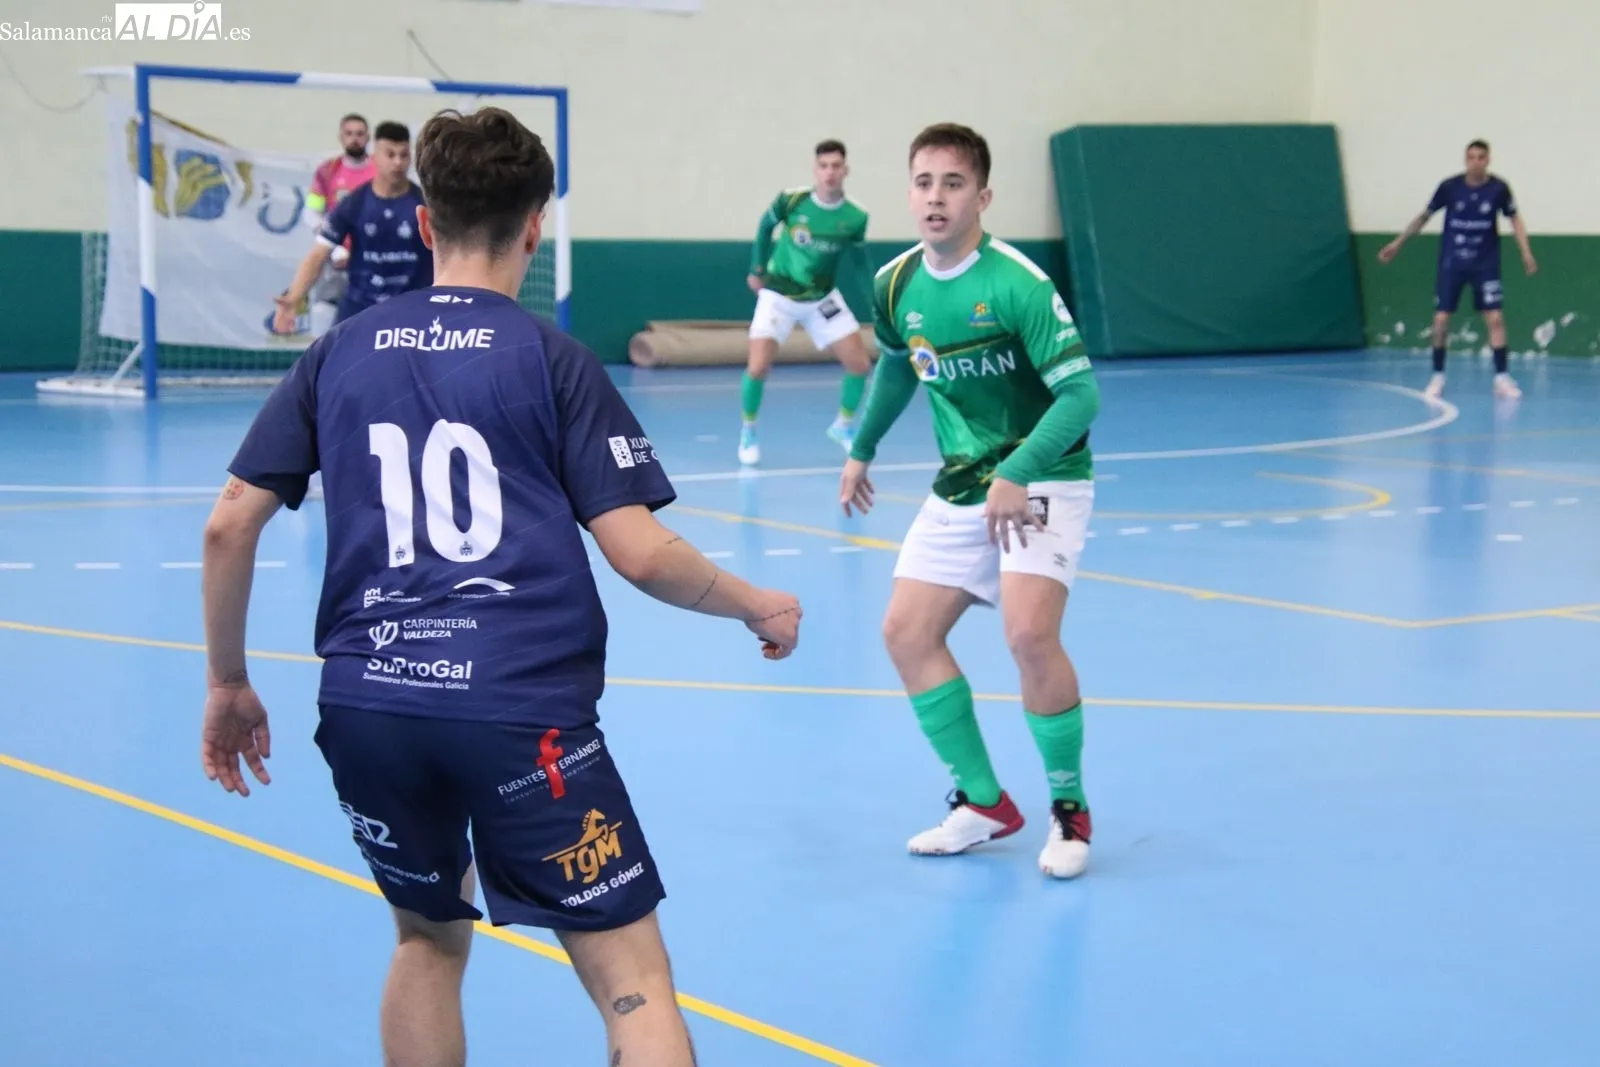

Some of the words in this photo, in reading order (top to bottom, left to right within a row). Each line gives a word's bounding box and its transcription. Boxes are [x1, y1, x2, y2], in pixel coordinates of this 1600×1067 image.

[374, 315, 495, 351] DISLUME
[633, 451, 650, 464] DE
[368, 418, 503, 569] 10
[403, 617, 478, 630] CARPINTERÍA
[403, 630, 452, 640] VALDEZA
[367, 657, 473, 680] SuProGal
[401, 678, 444, 689] Profesionales
[445, 681, 469, 690] Galicia
[497, 769, 547, 796] FUENTES
[560, 882, 609, 907] TOLDOS
[609, 862, 645, 889] GÓMEZ
